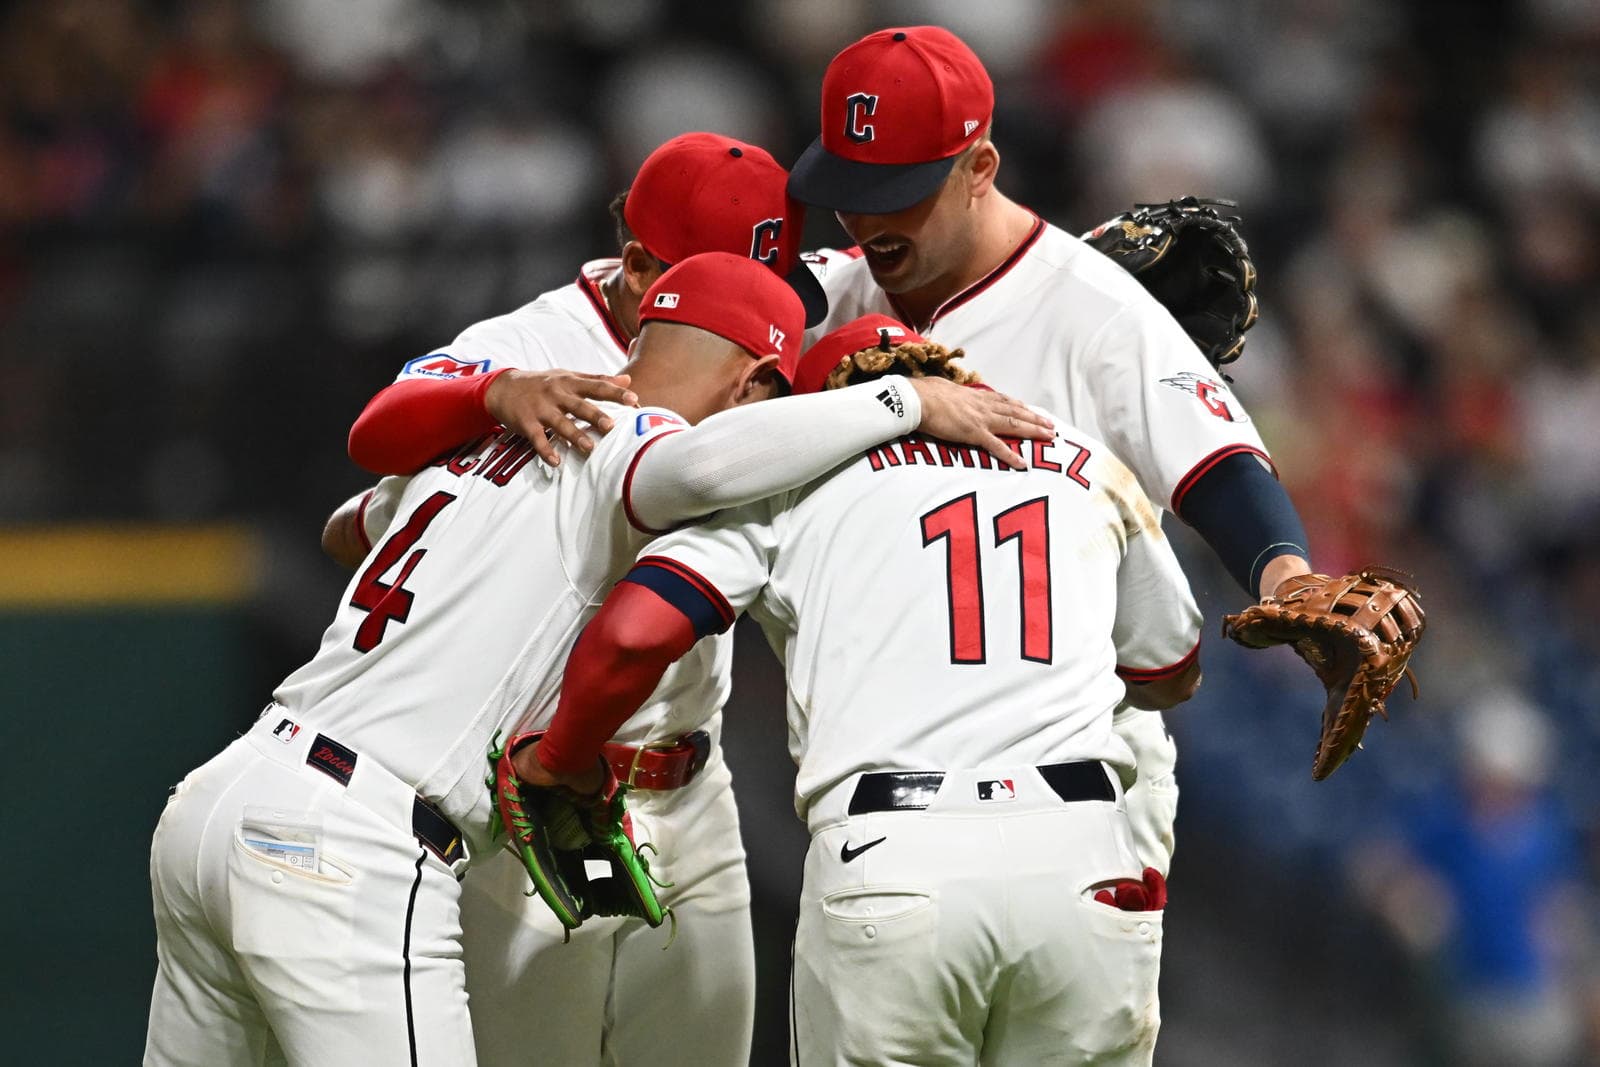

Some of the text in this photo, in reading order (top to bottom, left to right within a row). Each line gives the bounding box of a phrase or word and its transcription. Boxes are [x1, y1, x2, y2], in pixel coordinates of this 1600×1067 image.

[844, 92, 879, 144] C
[750, 218, 783, 266] C
[768, 323, 786, 352] VZ
[1196, 380, 1234, 422] G
[349, 490, 458, 654] 4
[919, 490, 1053, 666] 11
